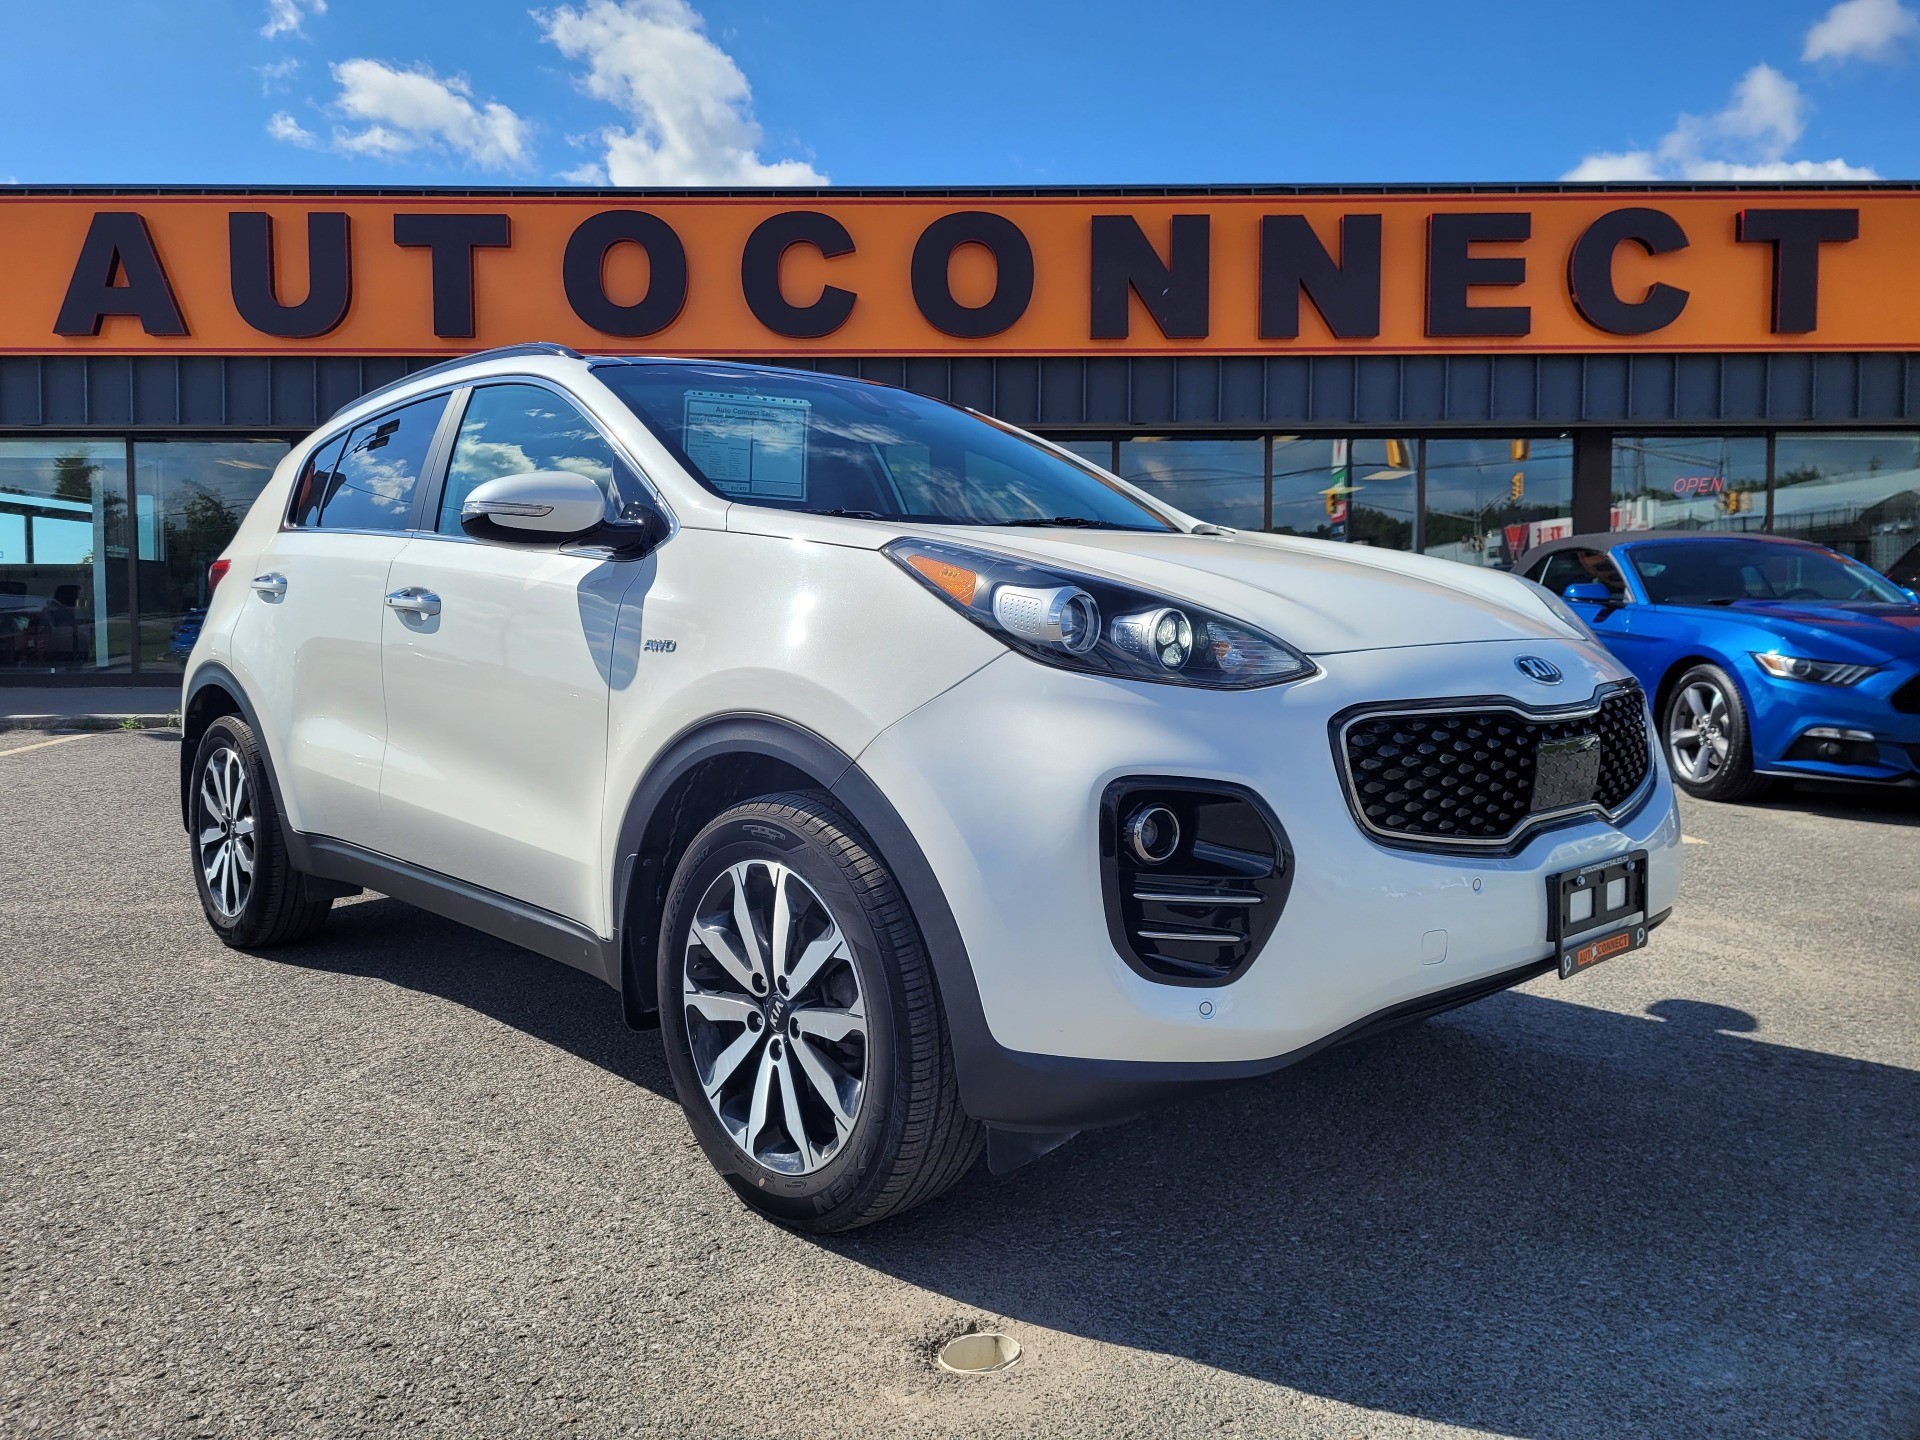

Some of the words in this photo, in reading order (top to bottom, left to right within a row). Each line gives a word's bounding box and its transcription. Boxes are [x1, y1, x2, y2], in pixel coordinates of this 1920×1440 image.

[52, 207, 1860, 340] AUTOCONNECT
[715, 406, 732, 414] Auto
[732, 408, 760, 416] Connect
[1673, 476, 1725, 493] OPEN
[643, 639, 677, 653] AWD
[769, 1000, 784, 1028] KIA
[811, 1100, 885, 1216] NEXEN
